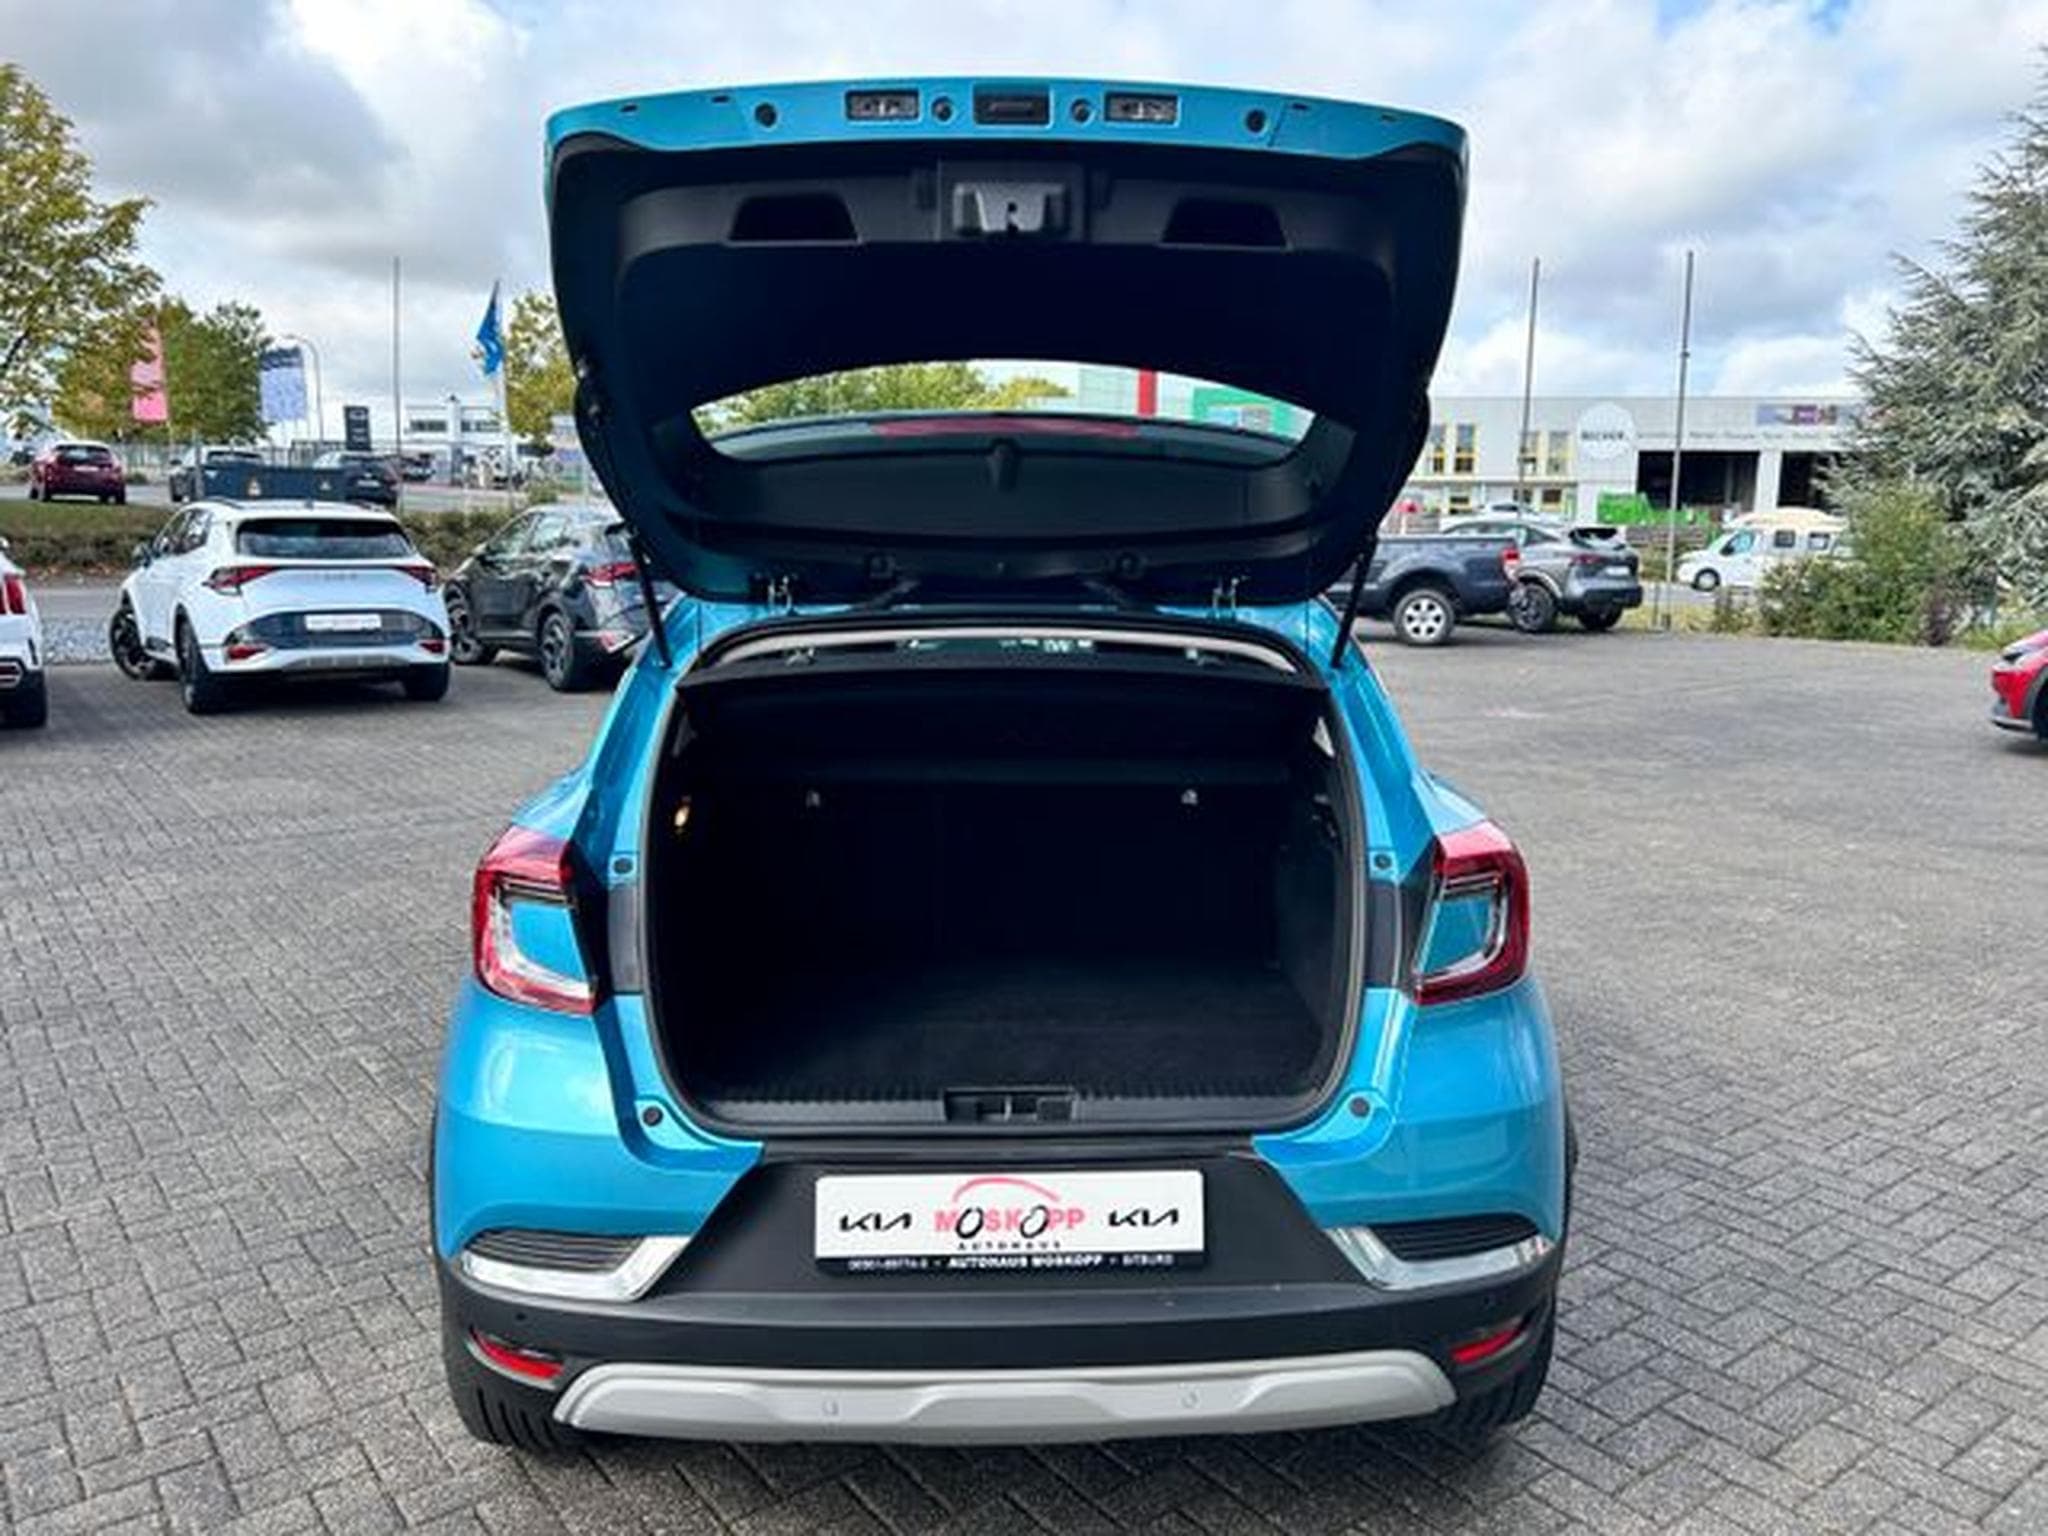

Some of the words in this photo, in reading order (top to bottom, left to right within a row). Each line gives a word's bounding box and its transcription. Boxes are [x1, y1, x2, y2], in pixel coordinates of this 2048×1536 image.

[839, 1211, 912, 1232] KIA
[934, 1206, 1085, 1239] MOSKOPP
[1108, 1207, 1179, 1227] KIA
[957, 1240, 1061, 1251] AUTOHAUS
[948, 1256, 1028, 1269] AUTOHAUS
[1031, 1254, 1103, 1268] MOSKOPP
